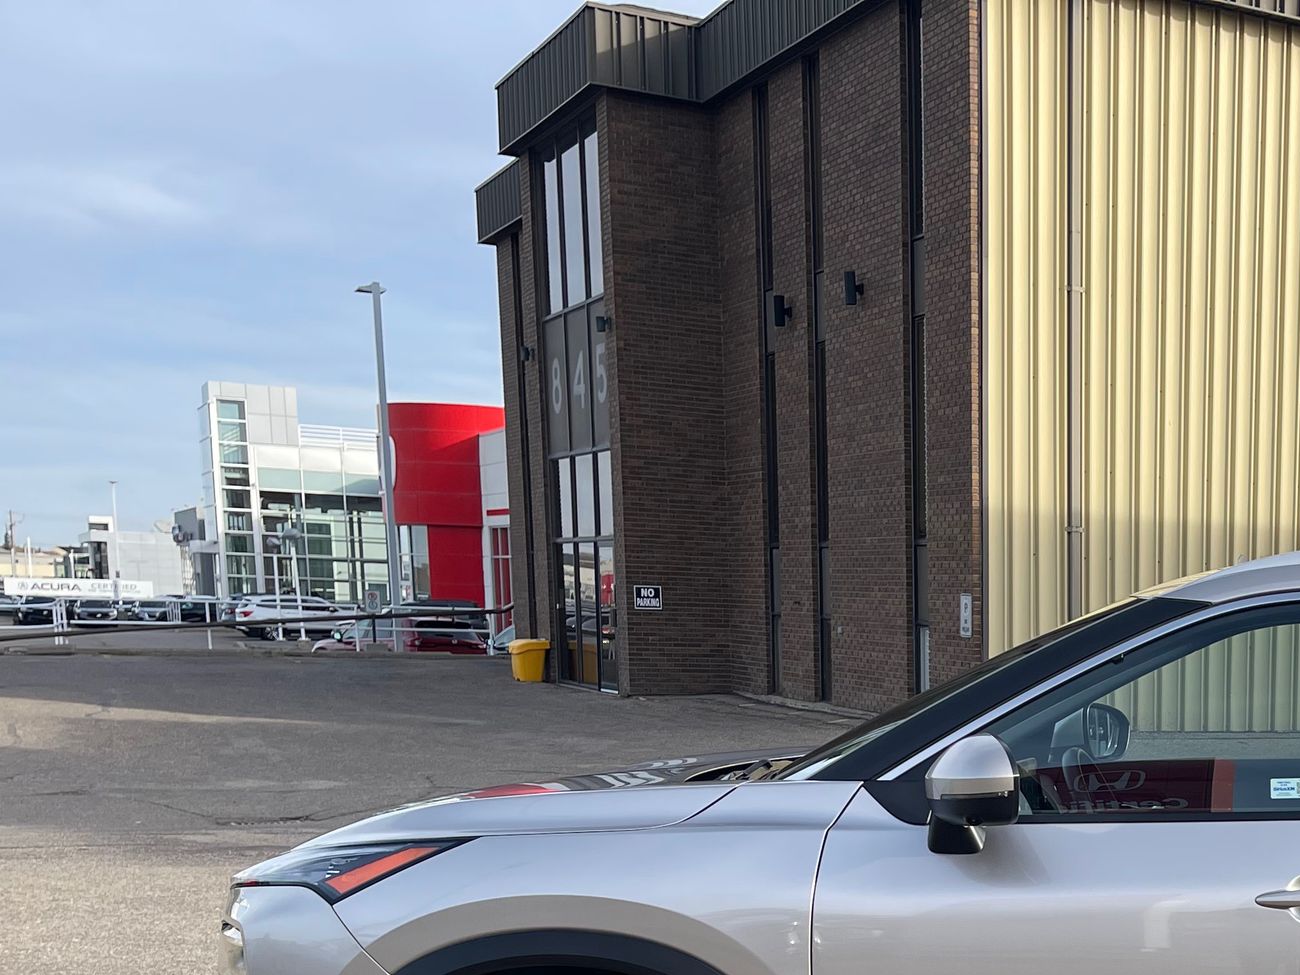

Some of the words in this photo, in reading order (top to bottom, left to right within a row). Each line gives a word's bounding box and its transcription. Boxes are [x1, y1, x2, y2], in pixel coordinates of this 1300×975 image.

[30, 582, 81, 592] ACURA
[91, 582, 137, 590] CERTIED
[641, 588, 655, 598] NO
[636, 597, 660, 607] PARKING
